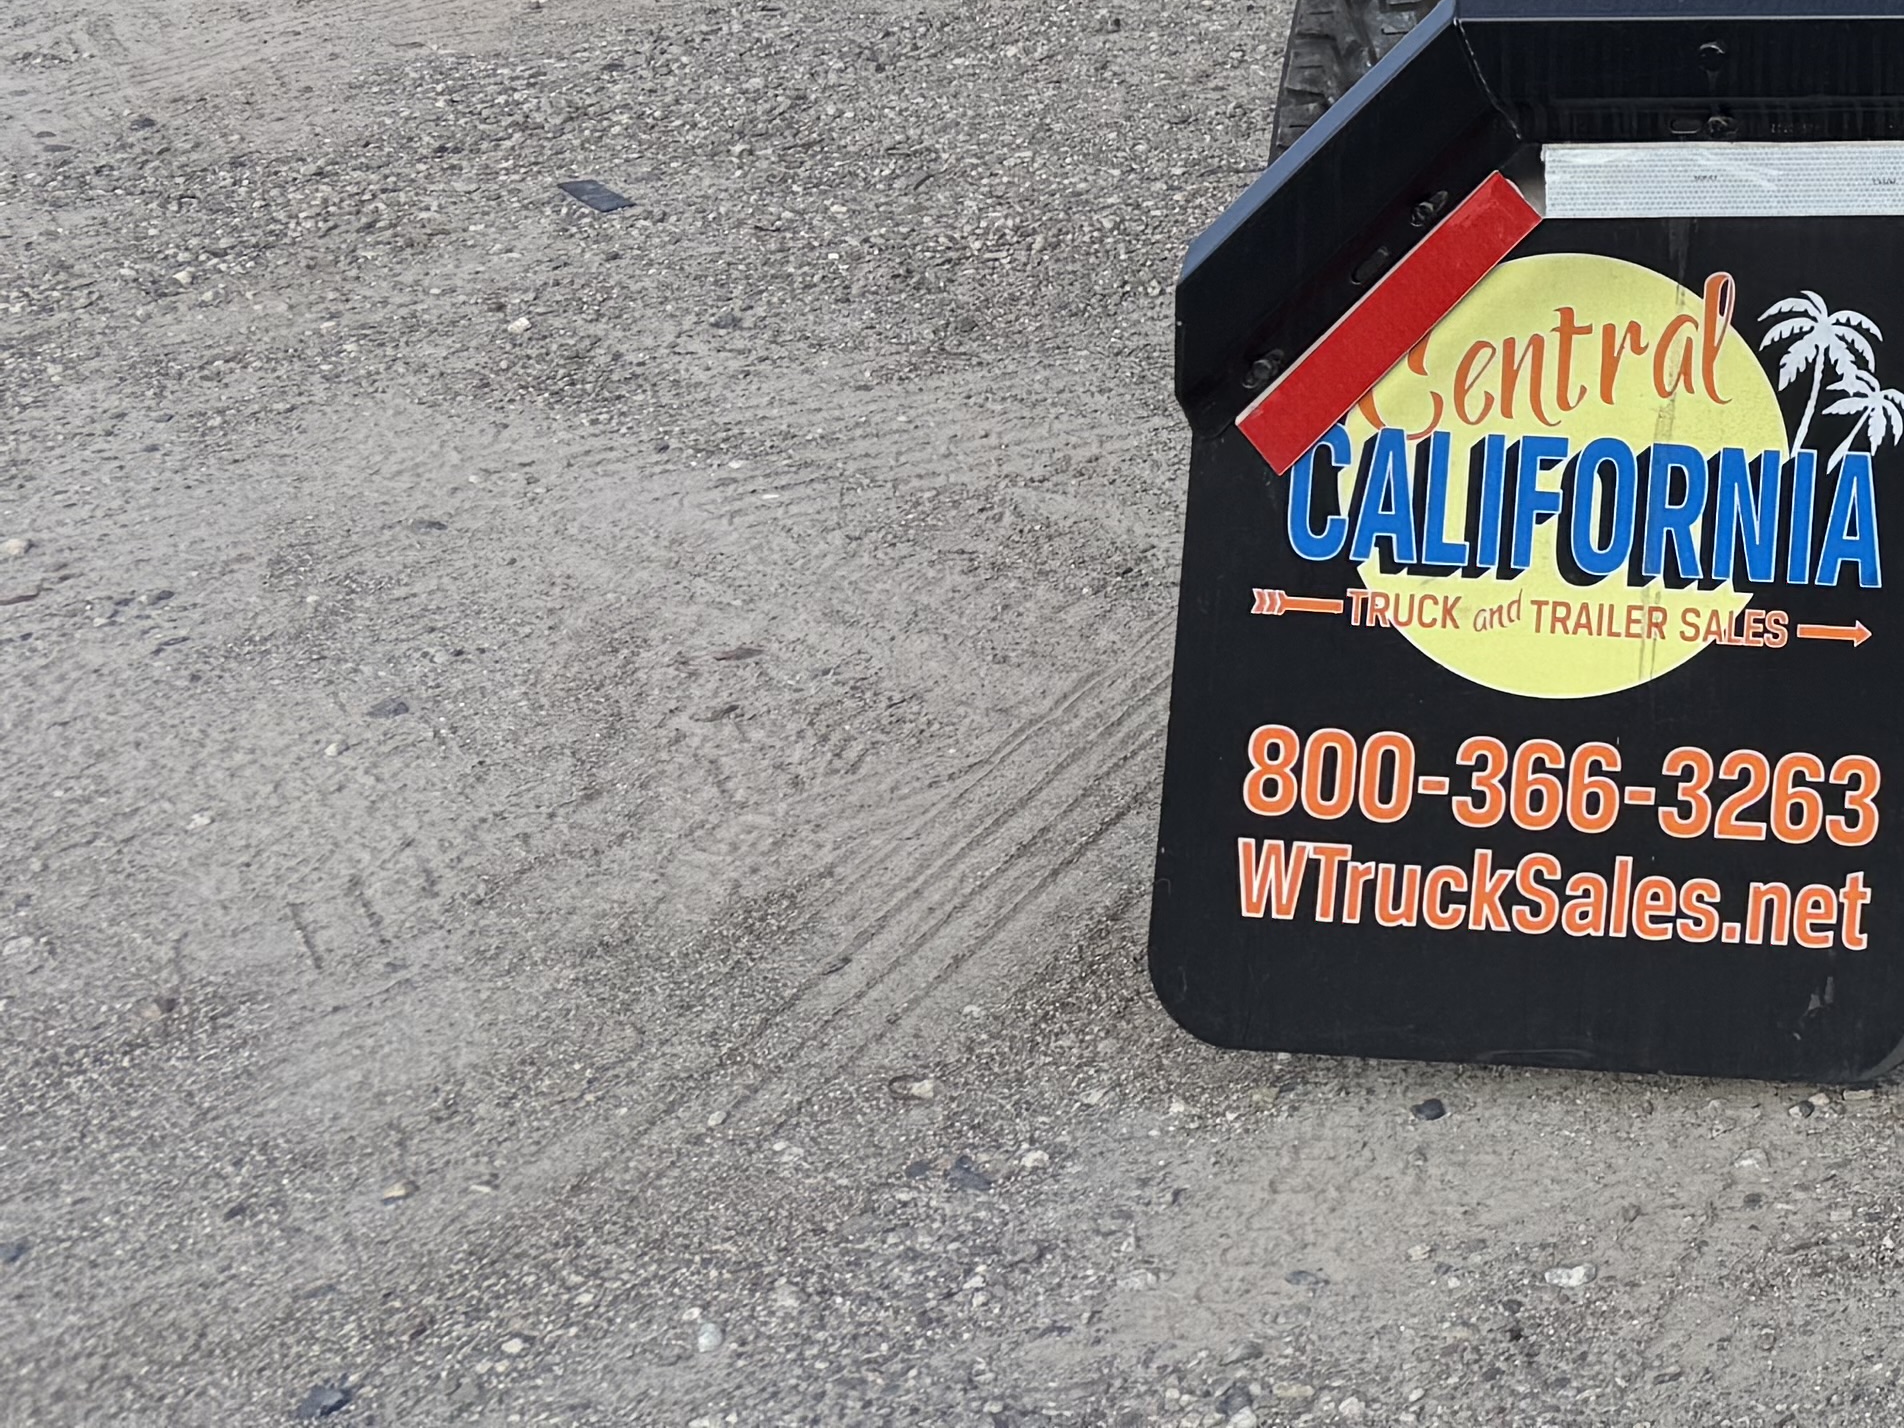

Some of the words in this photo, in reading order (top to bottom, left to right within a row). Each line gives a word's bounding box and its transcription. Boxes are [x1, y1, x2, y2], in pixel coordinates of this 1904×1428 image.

[1358, 271, 1736, 441] Central
[1287, 422, 1882, 589] CALIFORNIA
[1346, 589, 1462, 631] TRUCK
[1471, 592, 1524, 634] and
[1532, 599, 1668, 642] TRAILER
[1678, 608, 1790, 649] SALES
[1241, 723, 1882, 848] 800-366-3263
[1237, 837, 1872, 951] WTruckSales.net
